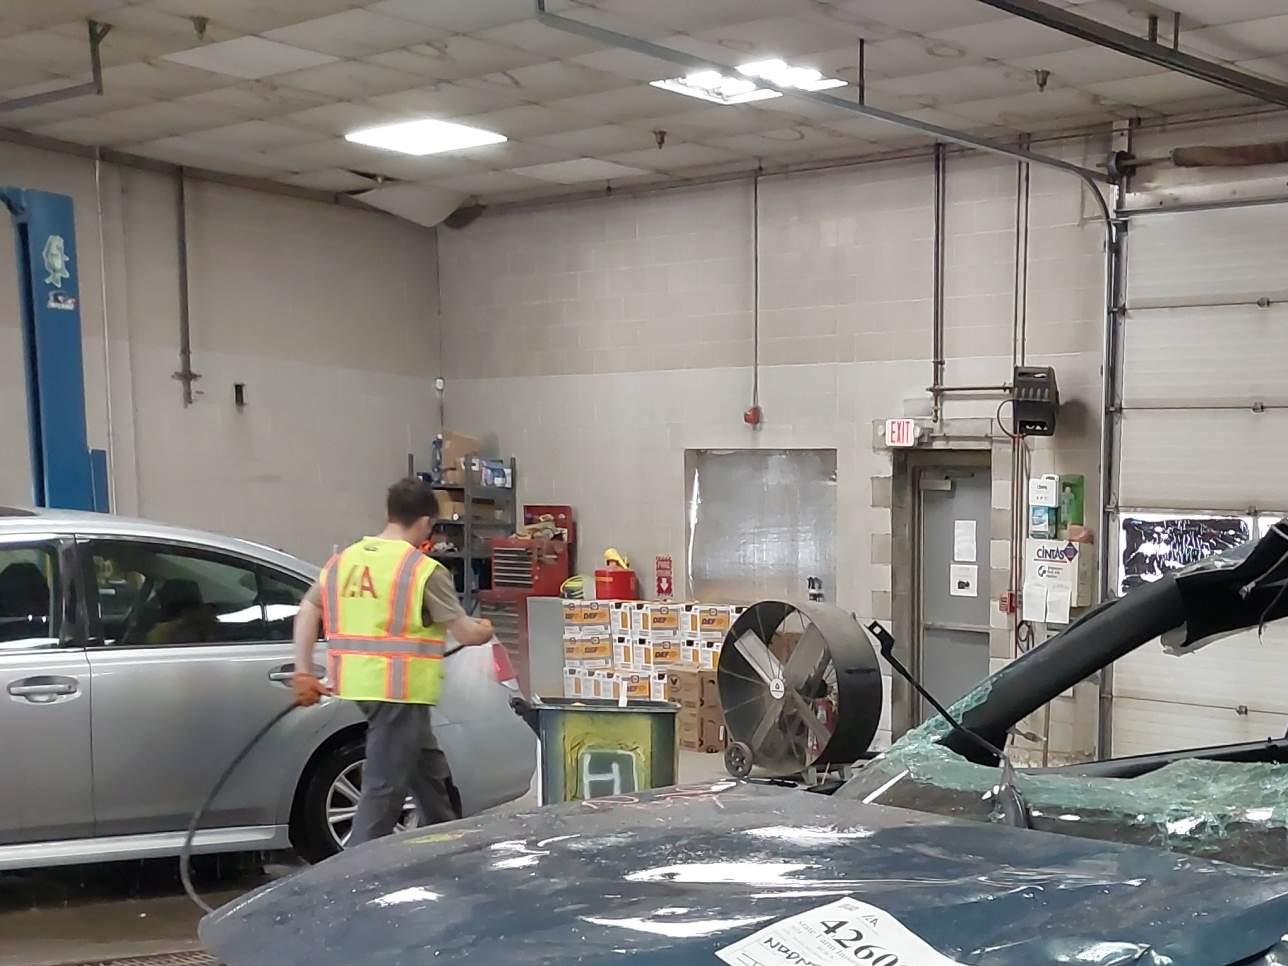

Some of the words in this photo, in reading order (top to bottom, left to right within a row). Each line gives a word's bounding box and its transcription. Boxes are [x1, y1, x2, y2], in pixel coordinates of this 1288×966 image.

[891, 421, 910, 443] EXIT
[1036, 545, 1065, 560] CINTAS
[583, 753, 621, 799] H
